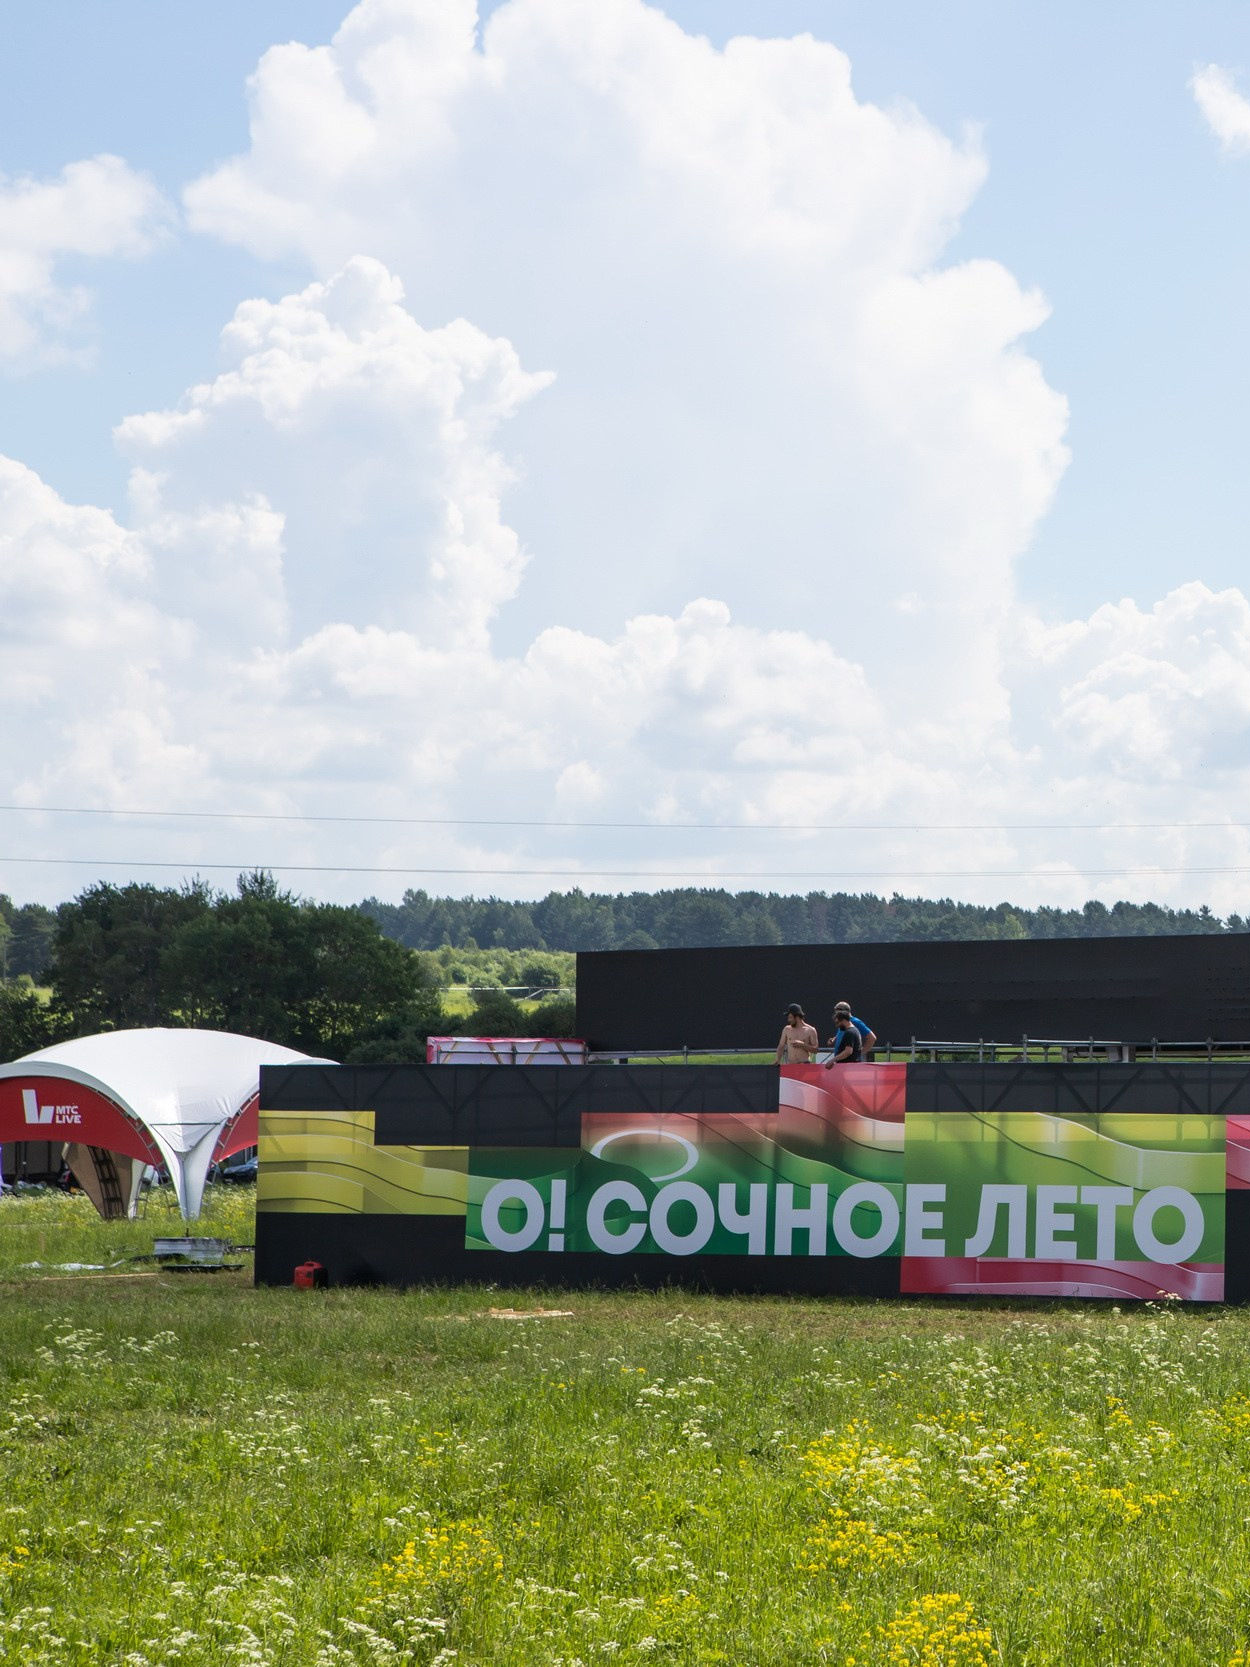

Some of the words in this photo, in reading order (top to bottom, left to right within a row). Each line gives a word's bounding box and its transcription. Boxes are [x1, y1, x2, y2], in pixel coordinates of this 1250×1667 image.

[56, 1115, 81, 1124] LIVE
[481, 1179, 567, 1252] О!
[586, 1180, 947, 1259] СОЧНОЕ
[965, 1184, 1205, 1265] ЛЕТО
